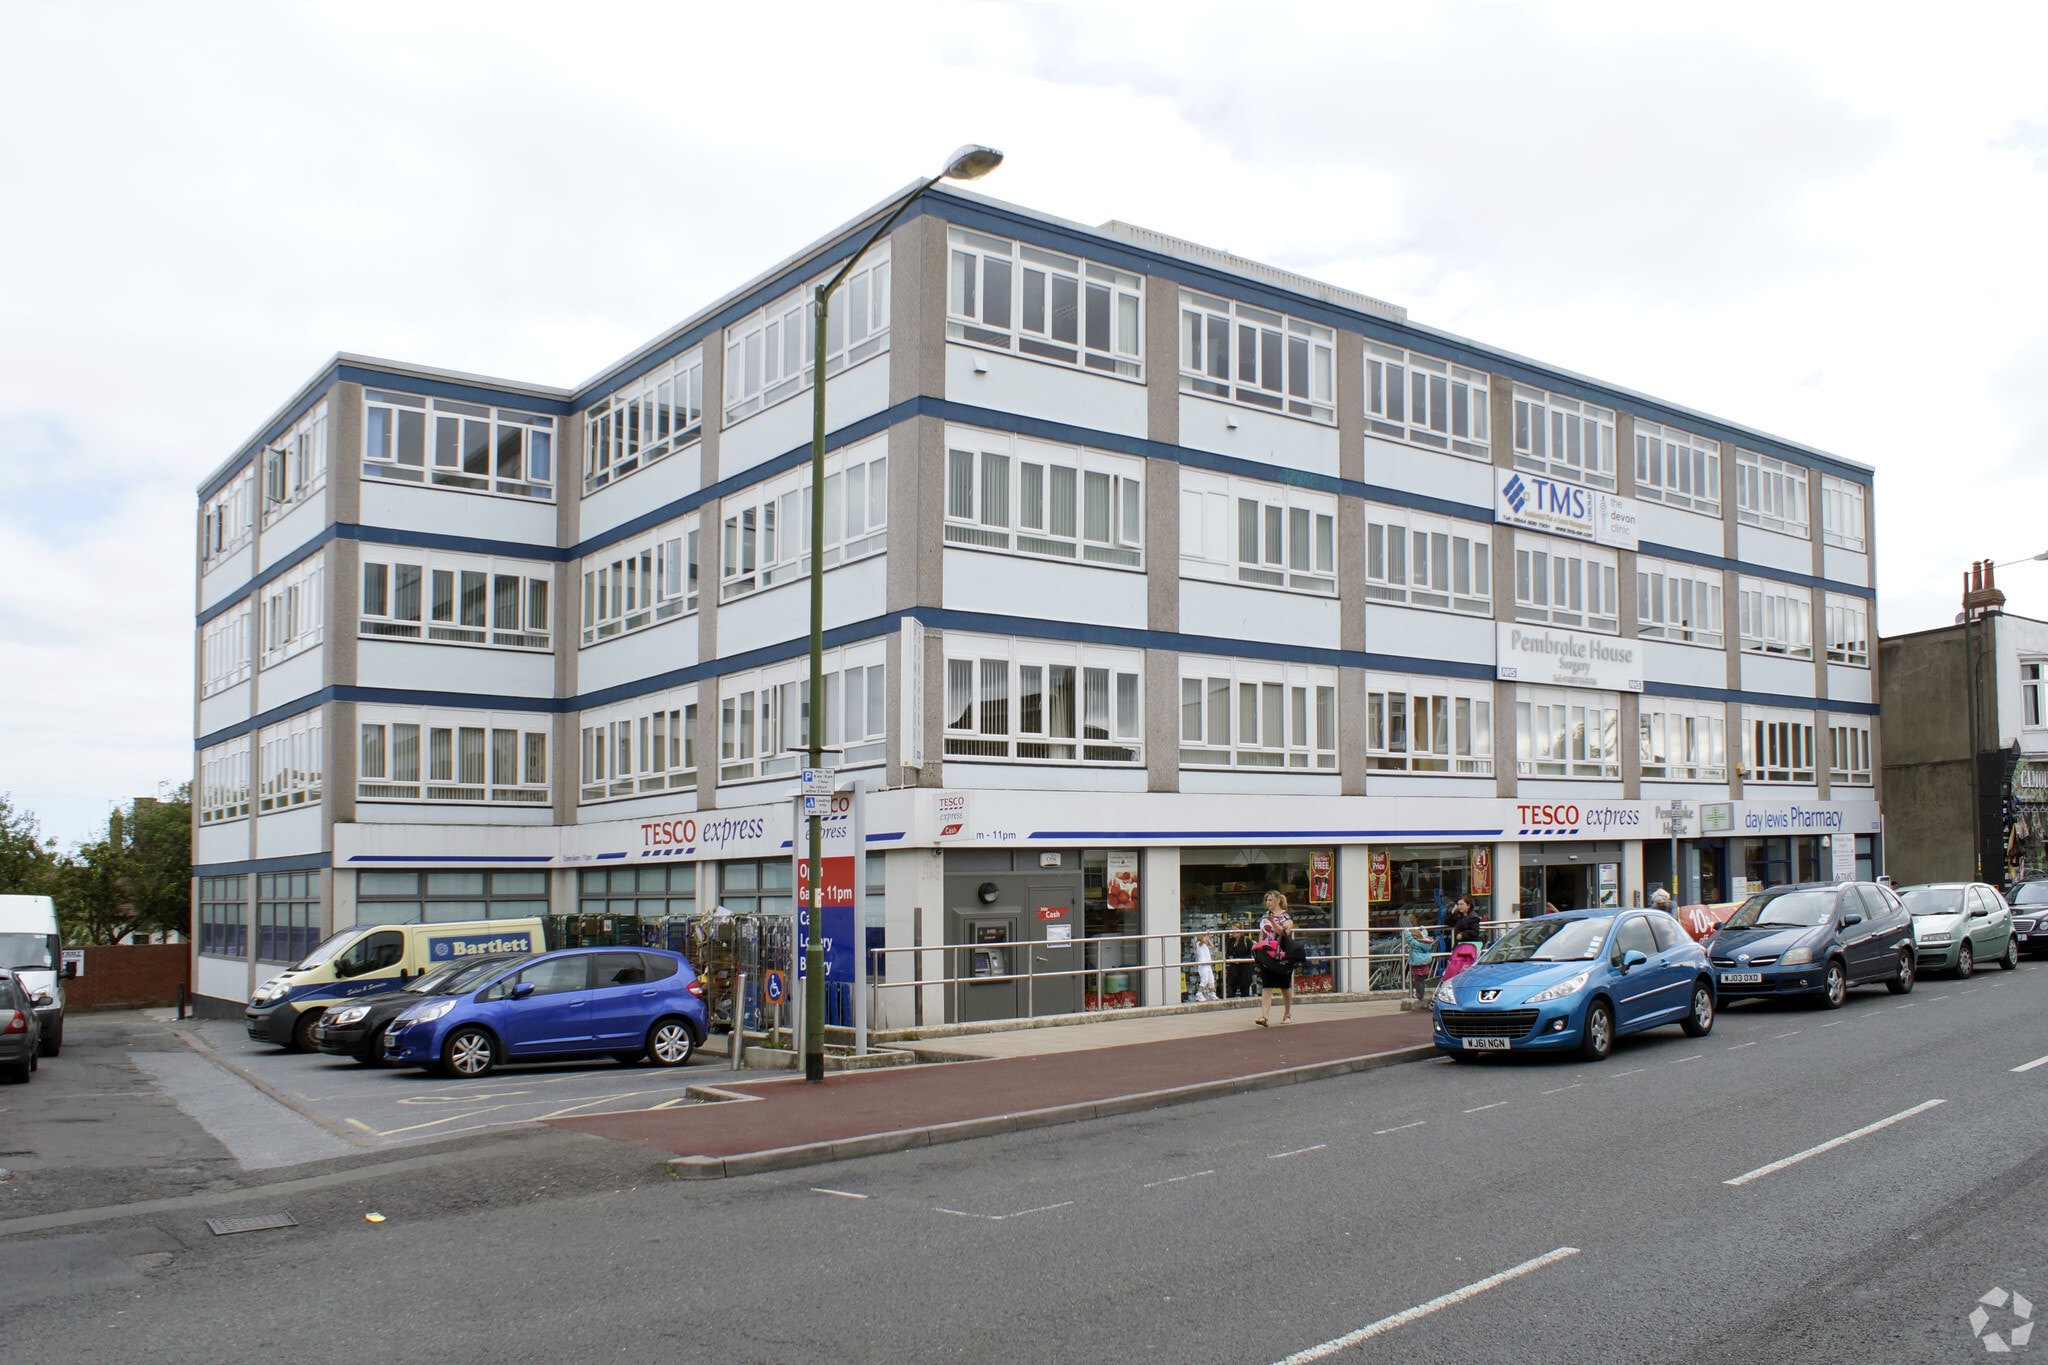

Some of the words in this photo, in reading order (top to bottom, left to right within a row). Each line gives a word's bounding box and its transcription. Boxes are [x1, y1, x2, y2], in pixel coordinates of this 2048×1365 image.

[1531, 479, 1585, 519] TMS
[1610, 498, 1623, 509] the
[1610, 511, 1636, 525] devon
[1610, 523, 1630, 536] clinic
[1511, 629, 1587, 660] Pembroke
[1589, 640, 1633, 664] House
[1502, 668, 1516, 677] NHS
[1558, 656, 1591, 676] Surgery
[1629, 680, 1641, 689] NHS
[939, 796, 964, 807] TESCO
[940, 812, 963, 822] express
[1517, 805, 1579, 825] TESCO
[1586, 806, 1639, 832] express
[1745, 810, 1763, 832] day
[1764, 810, 1788, 828] lewis
[1791, 806, 1843, 831] Pharmacy
[641, 819, 697, 846] TESCO
[703, 817, 764, 850] express
[993, 830, 1017, 841] 11pm
[1314, 862, 1329, 870] FREE
[1372, 862, 1385, 870] Price
[827, 885, 853, 903] 11pm
[452, 938, 528, 956] Bartlett
[1467, 1039, 1486, 1048] WJ61
[1488, 1038, 1506, 1048] NGN
